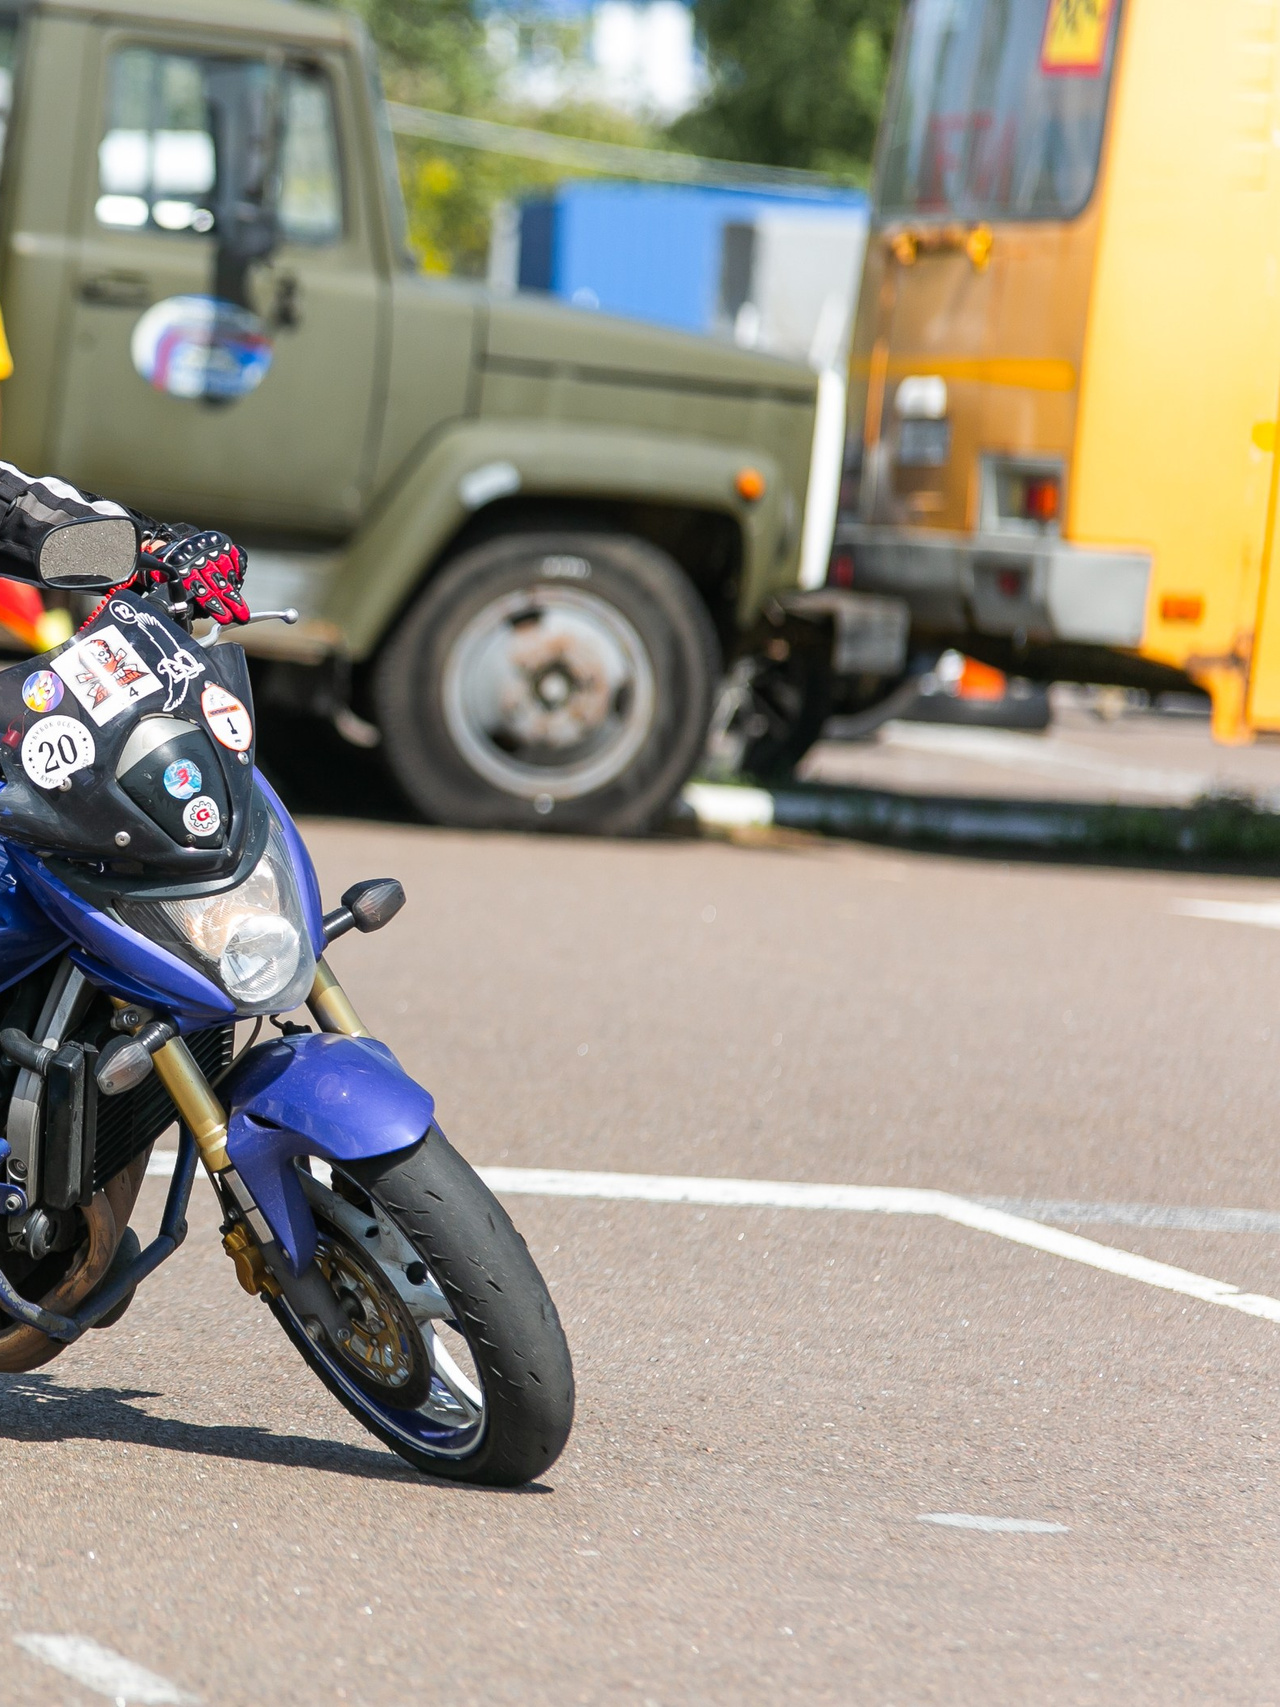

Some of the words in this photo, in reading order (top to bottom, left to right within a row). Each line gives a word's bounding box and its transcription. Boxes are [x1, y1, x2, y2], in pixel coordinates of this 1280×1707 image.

[114, 604, 135, 620] 12
[129, 686, 140, 698] 4
[226, 717, 238, 735] 1
[38, 734, 78, 774] 20
[176, 768, 190, 790] 3
[196, 808, 210, 822] G
